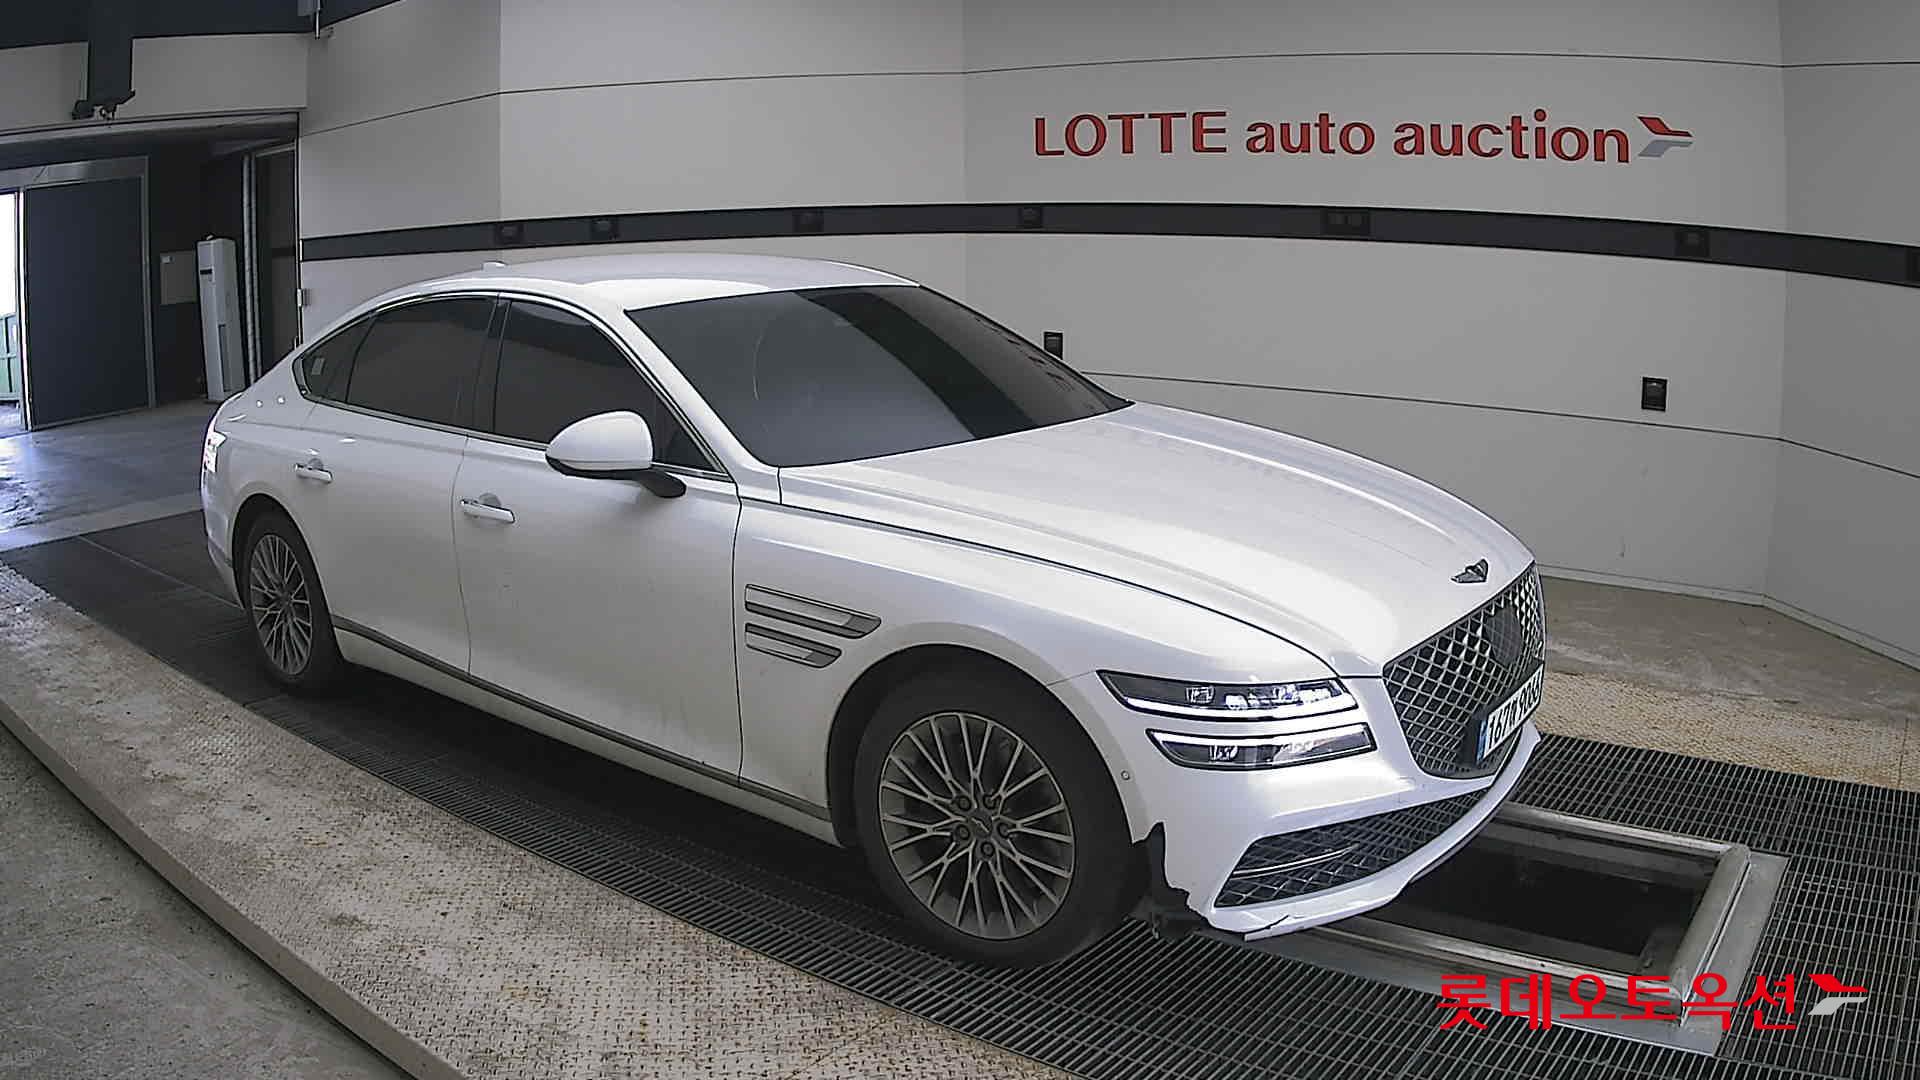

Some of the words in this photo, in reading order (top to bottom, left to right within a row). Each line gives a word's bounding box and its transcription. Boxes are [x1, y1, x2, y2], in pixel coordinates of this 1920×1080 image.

[1035, 112, 1227, 156] LOTTE
[1246, 113, 1375, 155] auto
[1394, 109, 1631, 163] auction
